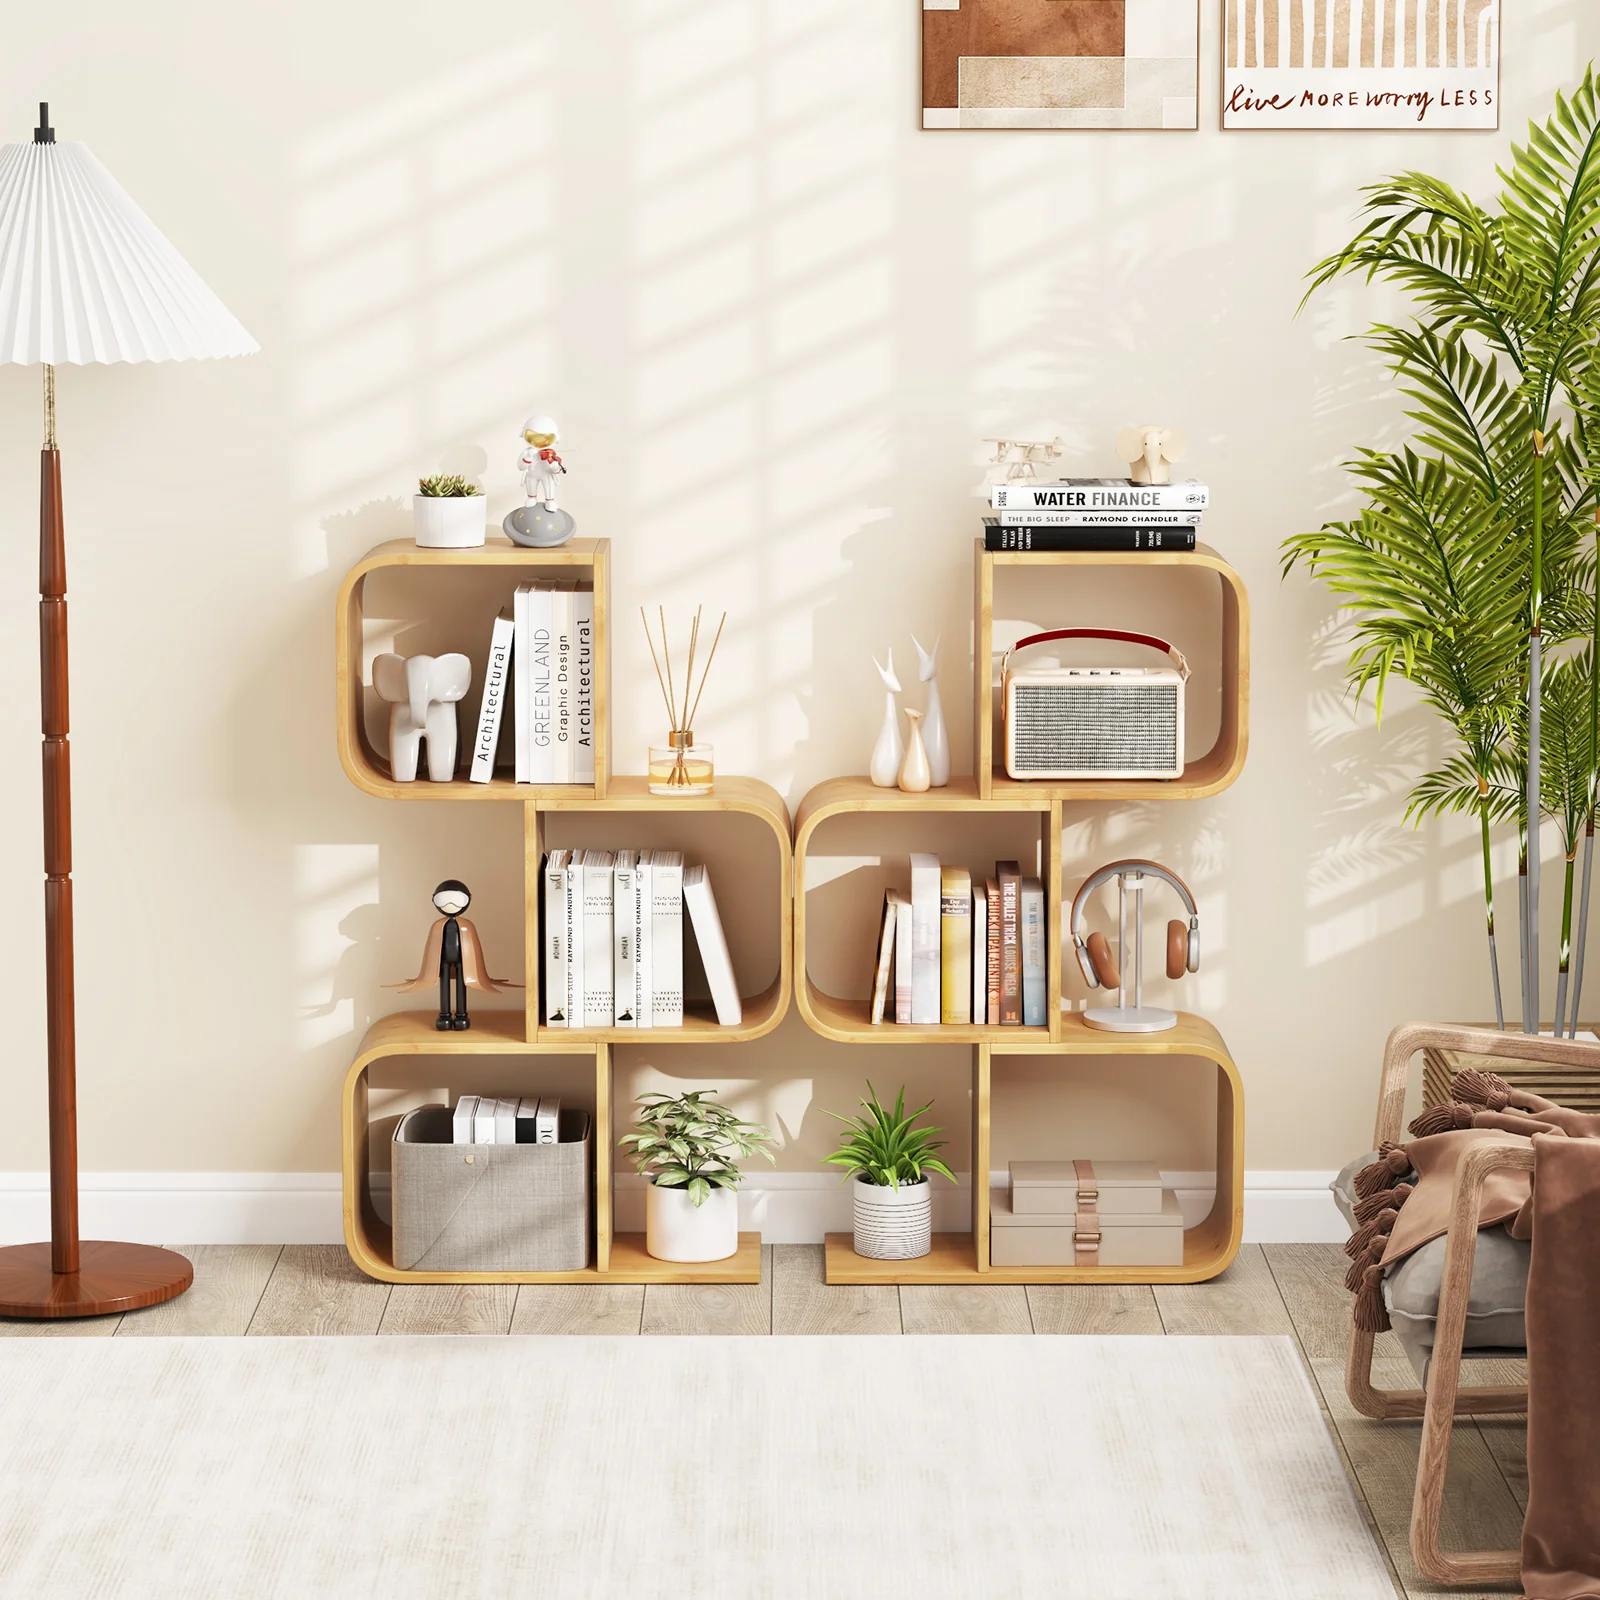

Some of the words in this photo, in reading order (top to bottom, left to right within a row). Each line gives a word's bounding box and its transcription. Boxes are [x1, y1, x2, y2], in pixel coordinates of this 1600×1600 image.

[1223, 83, 1297, 112] live
[1299, 89, 1358, 107] MORE
[1366, 90, 1435, 121] worry
[1441, 88, 1492, 106] LESS
[1034, 492, 1086, 506] WATER
[1092, 492, 1161, 506] FINANCE
[557, 635, 570, 682] Design
[534, 628, 551, 747] GREENLAND
[577, 618, 591, 747] Architectural
[477, 645, 507, 762] Architectural
[557, 688, 570, 742] Graphic
[1003, 882, 1017, 896] THE
[988, 894, 1000, 926] CHUCK
[1003, 897, 1017, 922] BULLET
[1003, 923, 1017, 945] TRICK
[988, 936, 1000, 993] PALAHNIUK
[1004, 945, 1017, 970] LOUISE
[1004, 972, 1017, 996] WELSH
